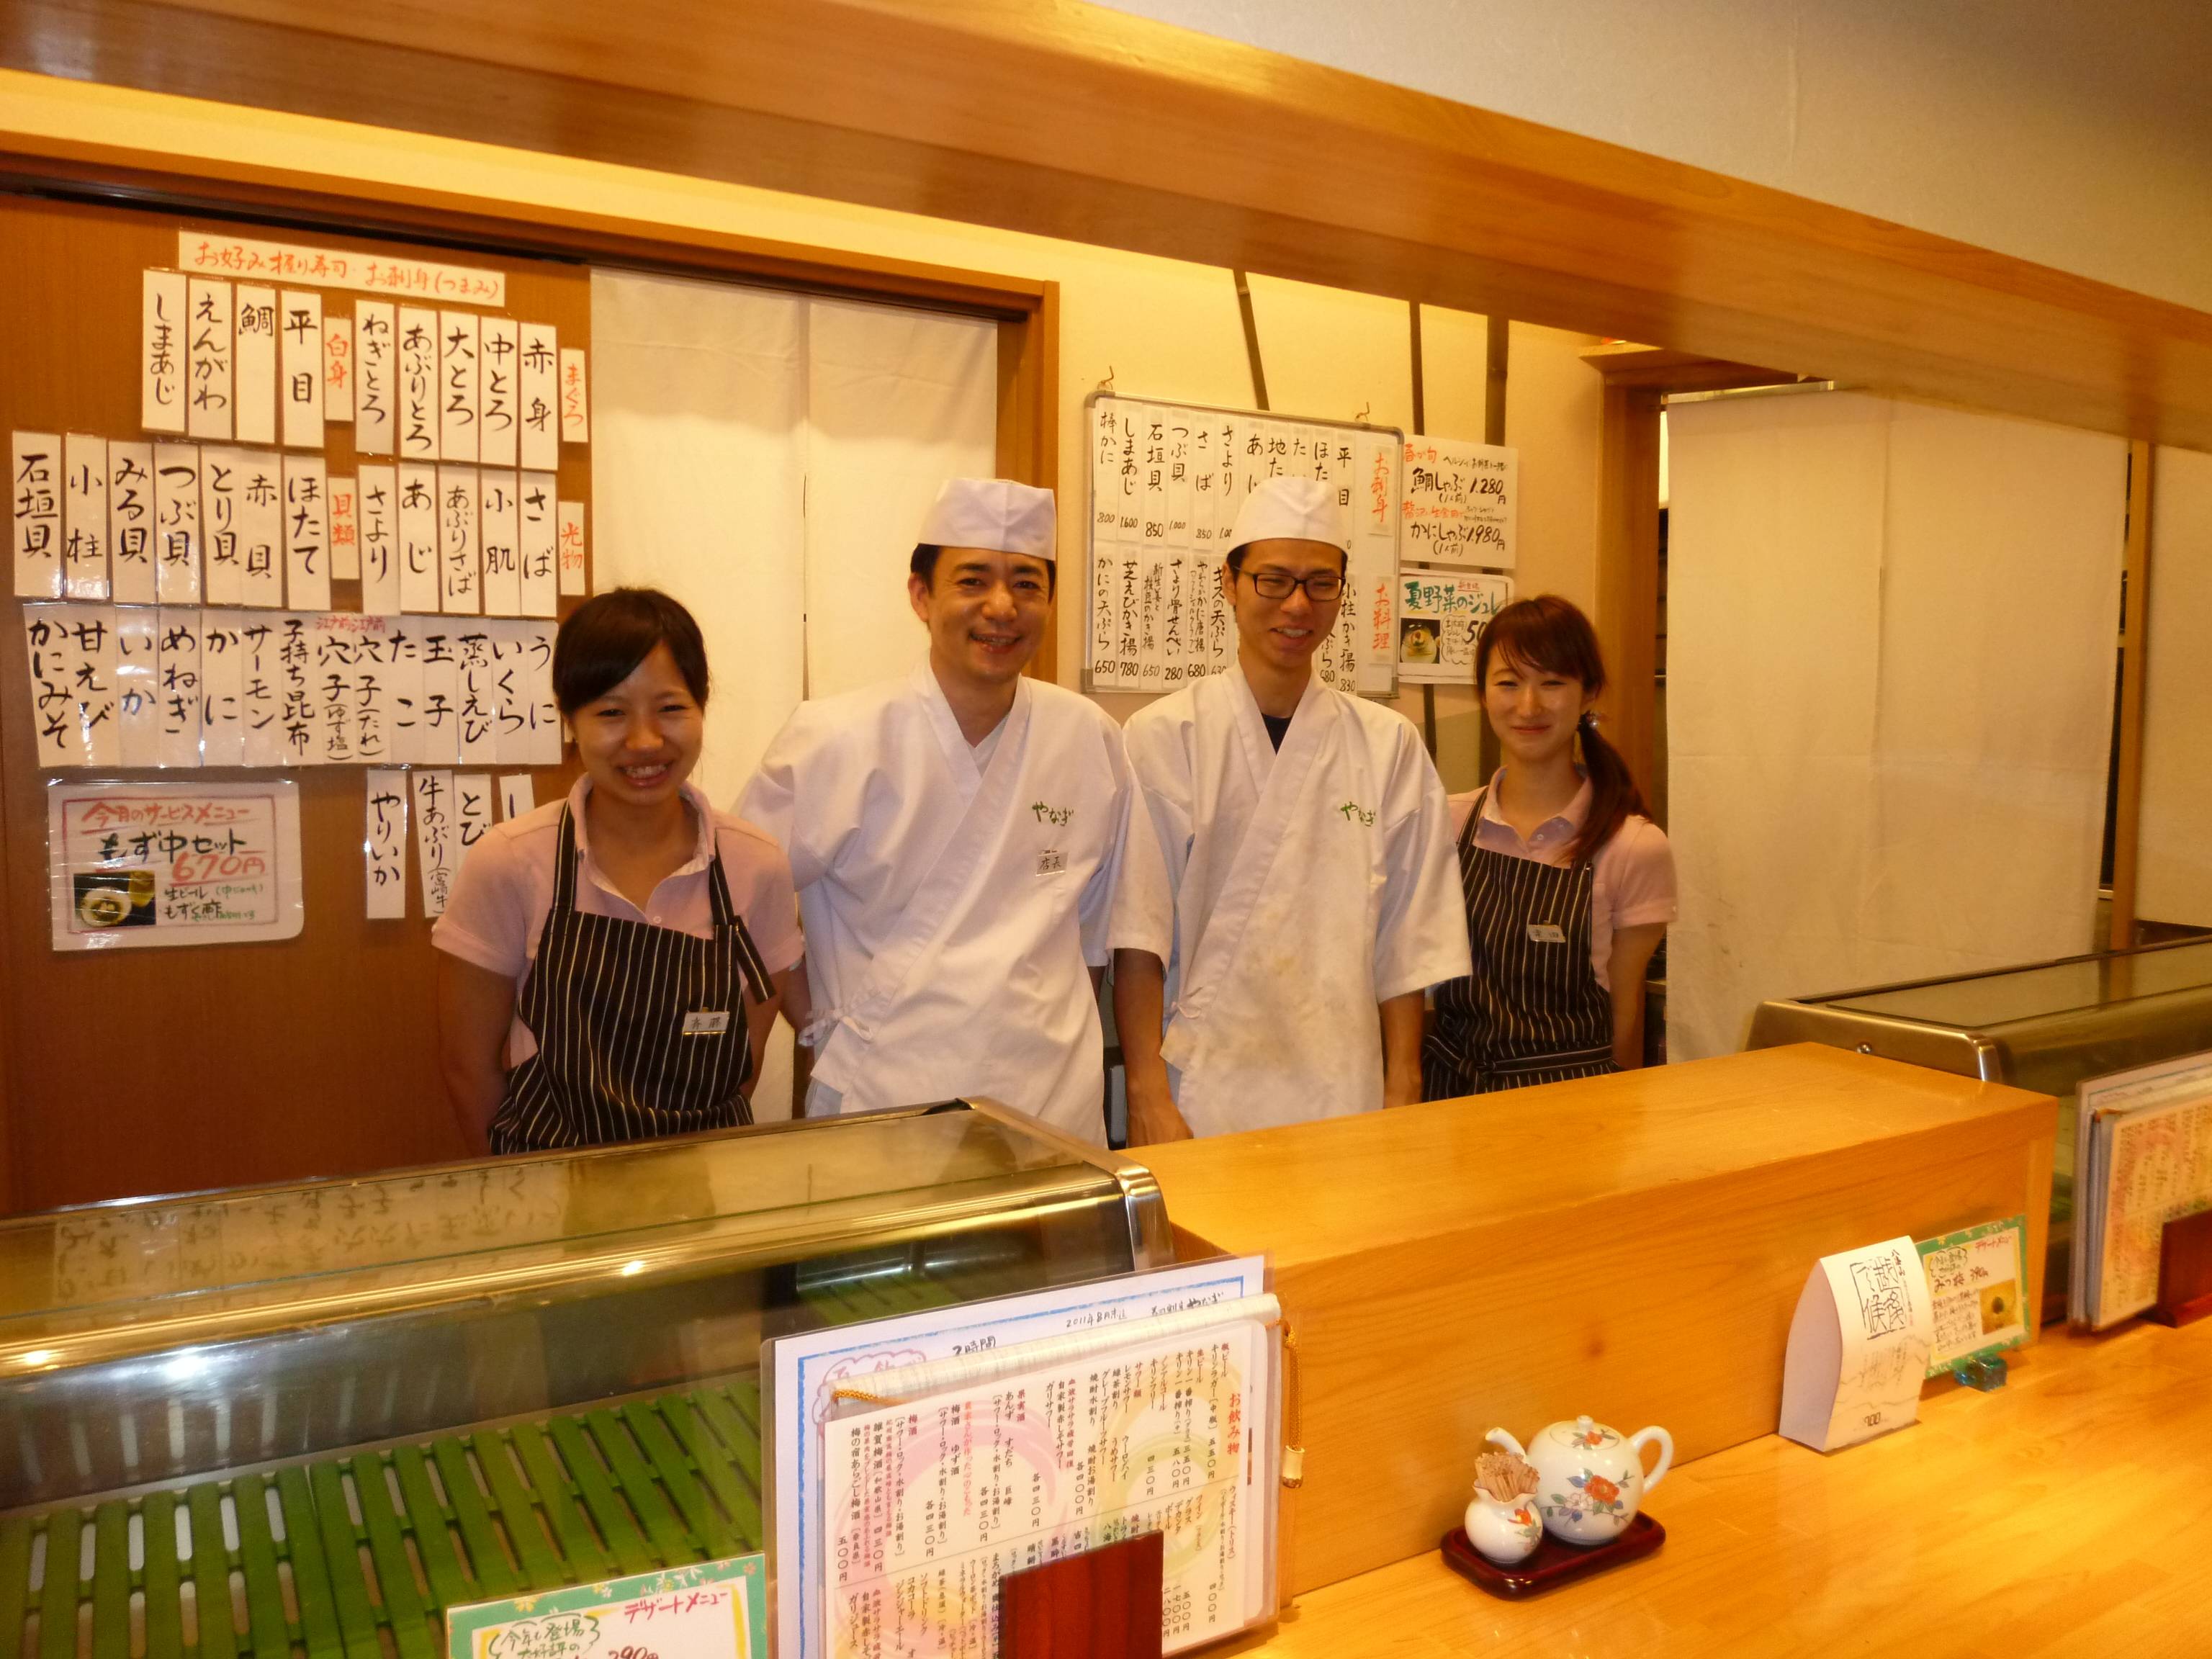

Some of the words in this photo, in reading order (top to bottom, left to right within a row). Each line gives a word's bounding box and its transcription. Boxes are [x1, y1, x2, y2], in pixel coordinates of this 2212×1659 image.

[150, 292, 174, 405] しまあじ
[193, 292, 227, 409] えんがわ
[238, 305, 274, 337] 鯛
[284, 309, 319, 403] 平目
[326, 334, 349, 389] 白身
[361, 313, 390, 424] ねぎとろ
[403, 324, 434, 451] あぶりとろ
[444, 327, 475, 425] 大とろ
[484, 333, 514, 431] 中とろ
[523, 338, 554, 431] 赤身
[564, 364, 585, 425] まぐろ
[1121, 418, 1138, 495] しまあじ
[1146, 423, 1165, 492] 石垣貝
[1170, 427, 1189, 482] つぶ貝
[1195, 431, 1213, 491] さば
[1222, 426, 1234, 496] さより
[1337, 448, 1352, 506] 平目
[1370, 452, 1389, 523] お刺身
[1411, 467, 1465, 494] 鯛しゃぶ
[15, 454, 58, 559] 石垣貝
[66, 465, 103, 559] 小柱
[114, 458, 148, 562] みる貝
[158, 466, 196, 567] つぶ貝
[210, 464, 240, 565] とり貝
[246, 475, 278, 579] 赤貝
[288, 475, 321, 575] ほたて
[332, 495, 355, 546] 貝類
[366, 485, 390, 583] さより
[400, 482, 432, 574] あじ
[446, 485, 472, 597] あぶりさば
[485, 488, 516, 572] 小肌
[522, 487, 554, 578] さば
[562, 521, 583, 570] 光物
[1097, 512, 1115, 523] 800
[1146, 523, 1163, 538] 850
[1195, 529, 1212, 540] 850
[1411, 521, 1467, 541] かにしゃぶ
[1097, 558, 1113, 651] かにの天ぷら
[1210, 567, 1225, 658] キスの天ぷら
[1373, 583, 1391, 650] お料理
[28, 618, 72, 750] かにみそ
[73, 621, 112, 729] 甘えび
[120, 636, 155, 716] いか
[160, 627, 200, 734] めねぎ
[205, 632, 238, 722] かに
[242, 625, 276, 729] サーモン
[282, 619, 315, 757] 子持ち昆布
[390, 629, 417, 728] たこ
[423, 636, 454, 728] 玉子
[458, 634, 490, 744] 蒸しえび
[492, 637, 524, 732] いくら
[529, 634, 555, 729] うに
[1094, 660, 1116, 674] 650
[1120, 662, 1139, 677] 780
[1143, 663, 1160, 677] 650
[1164, 667, 1183, 680] 280
[1188, 664, 1205, 678] 680
[1340, 679, 1355, 691] 830
[81, 801, 250, 830] 今月のサービスメニュー
[370, 793, 400, 884] やりいか
[1032, 801, 1074, 826] やなぎ
[171, 854, 266, 884] 670円
[909, 1414, 917, 1436] 梅酒
[951, 1404, 960, 1426] 梅酒
[1005, 1392, 1015, 1421] あんず
[1046, 1381, 1055, 1428] ガリサワー
[1227, 1393, 1241, 1455] お飲み物
[625, 1591, 729, 1623] デザートメニュー
